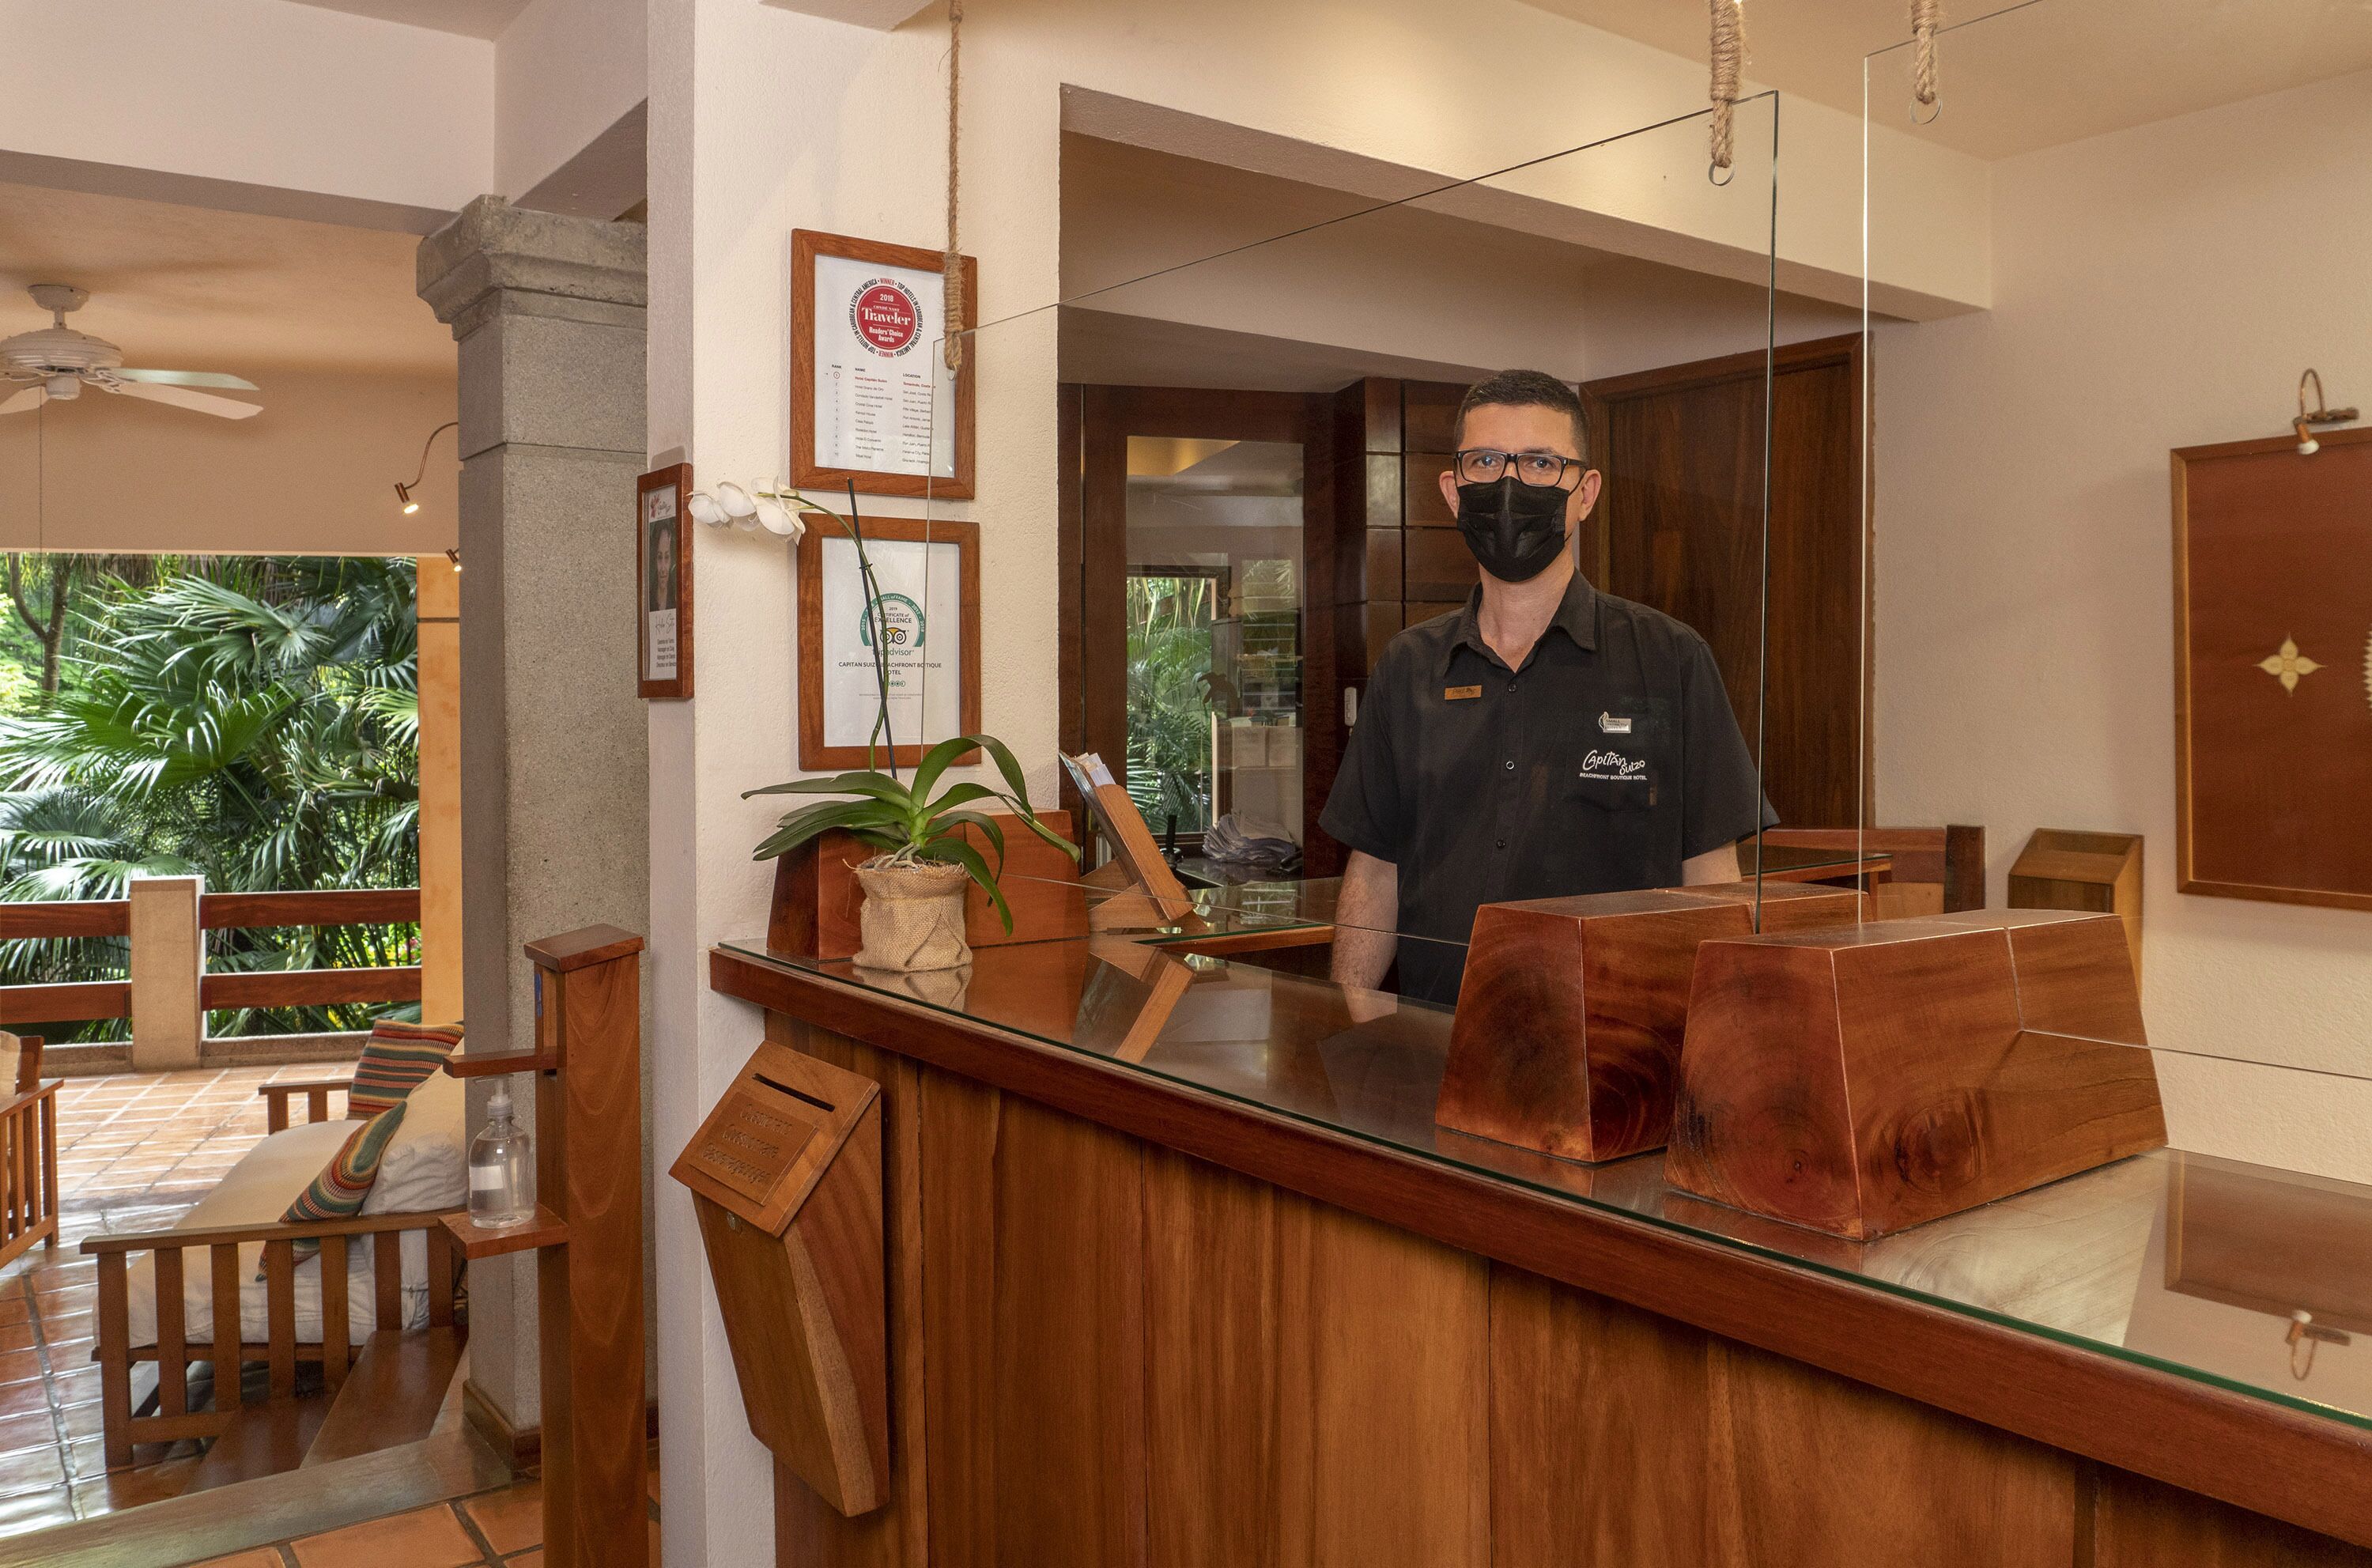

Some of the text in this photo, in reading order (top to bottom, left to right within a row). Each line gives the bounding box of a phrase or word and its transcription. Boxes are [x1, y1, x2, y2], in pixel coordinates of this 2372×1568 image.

[880, 293, 894, 302] 2018
[861, 307, 912, 326] Traveler
[889, 329, 904, 338] Choice
[878, 334, 895, 343] Awards
